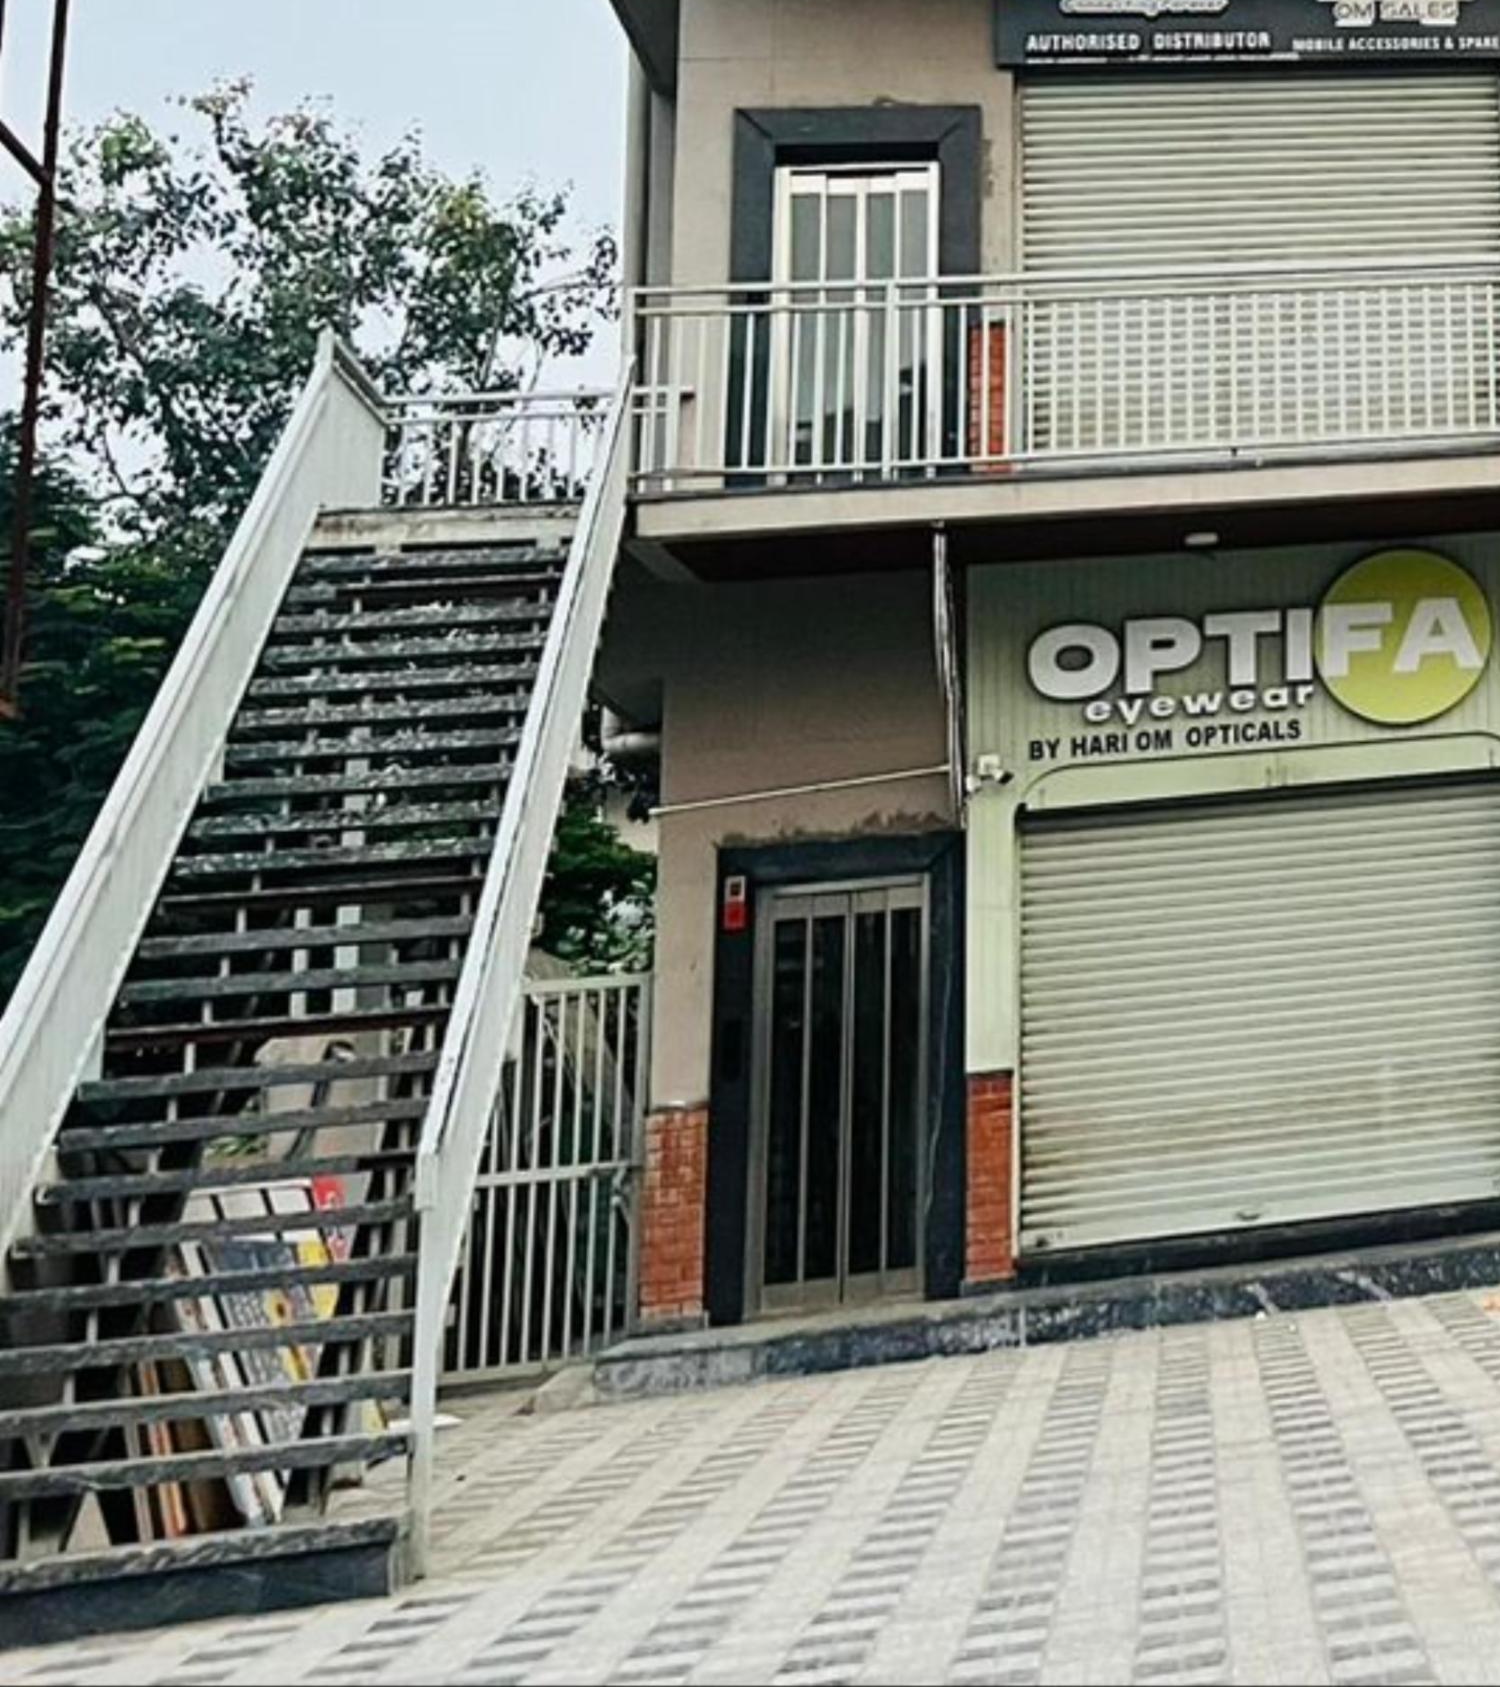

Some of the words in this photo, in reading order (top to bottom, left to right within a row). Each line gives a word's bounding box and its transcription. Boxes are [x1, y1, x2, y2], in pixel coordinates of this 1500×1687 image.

[1026, 33, 1141, 52] AUTHORISED
[1153, 31, 1271, 51] DISTRIBUTOR
[1292, 38, 1344, 51] MOBILE
[1348, 37, 1440, 50] ACCESSORIES
[1458, 36, 1500, 50] SPARE
[1027, 596, 1485, 701] OPTIFA
[1085, 682, 1314, 727] eyewear
[1029, 738, 1060, 761] BY
[1070, 733, 1127, 759] HARI
[1136, 729, 1174, 752] OM
[1185, 719, 1302, 748] OPTICALS
